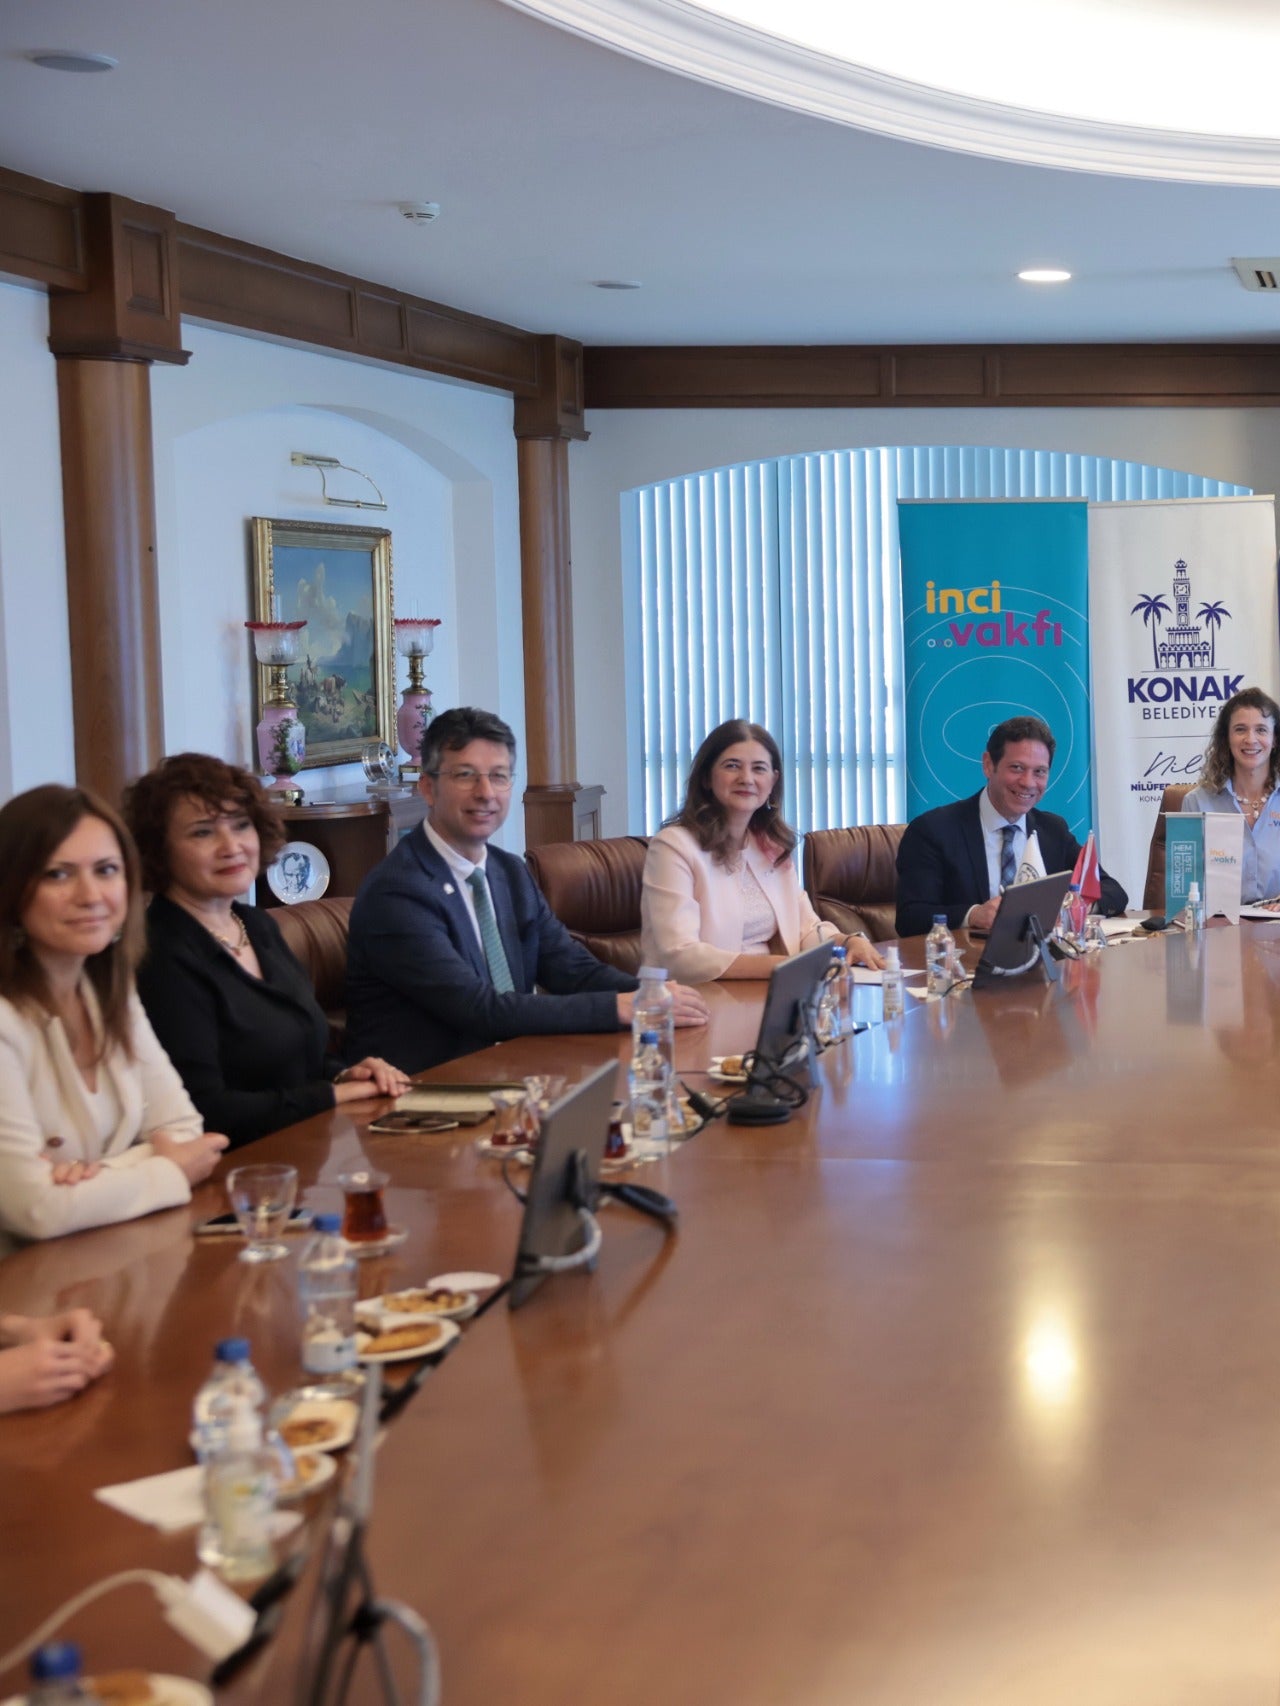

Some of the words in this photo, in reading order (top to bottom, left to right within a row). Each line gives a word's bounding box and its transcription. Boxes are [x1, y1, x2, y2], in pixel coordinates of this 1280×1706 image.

[926, 580, 1001, 614] inci
[949, 609, 1063, 647] vakfı
[1127, 675, 1245, 703] KONAK
[1142, 703, 1222, 720] BELEDİYE
